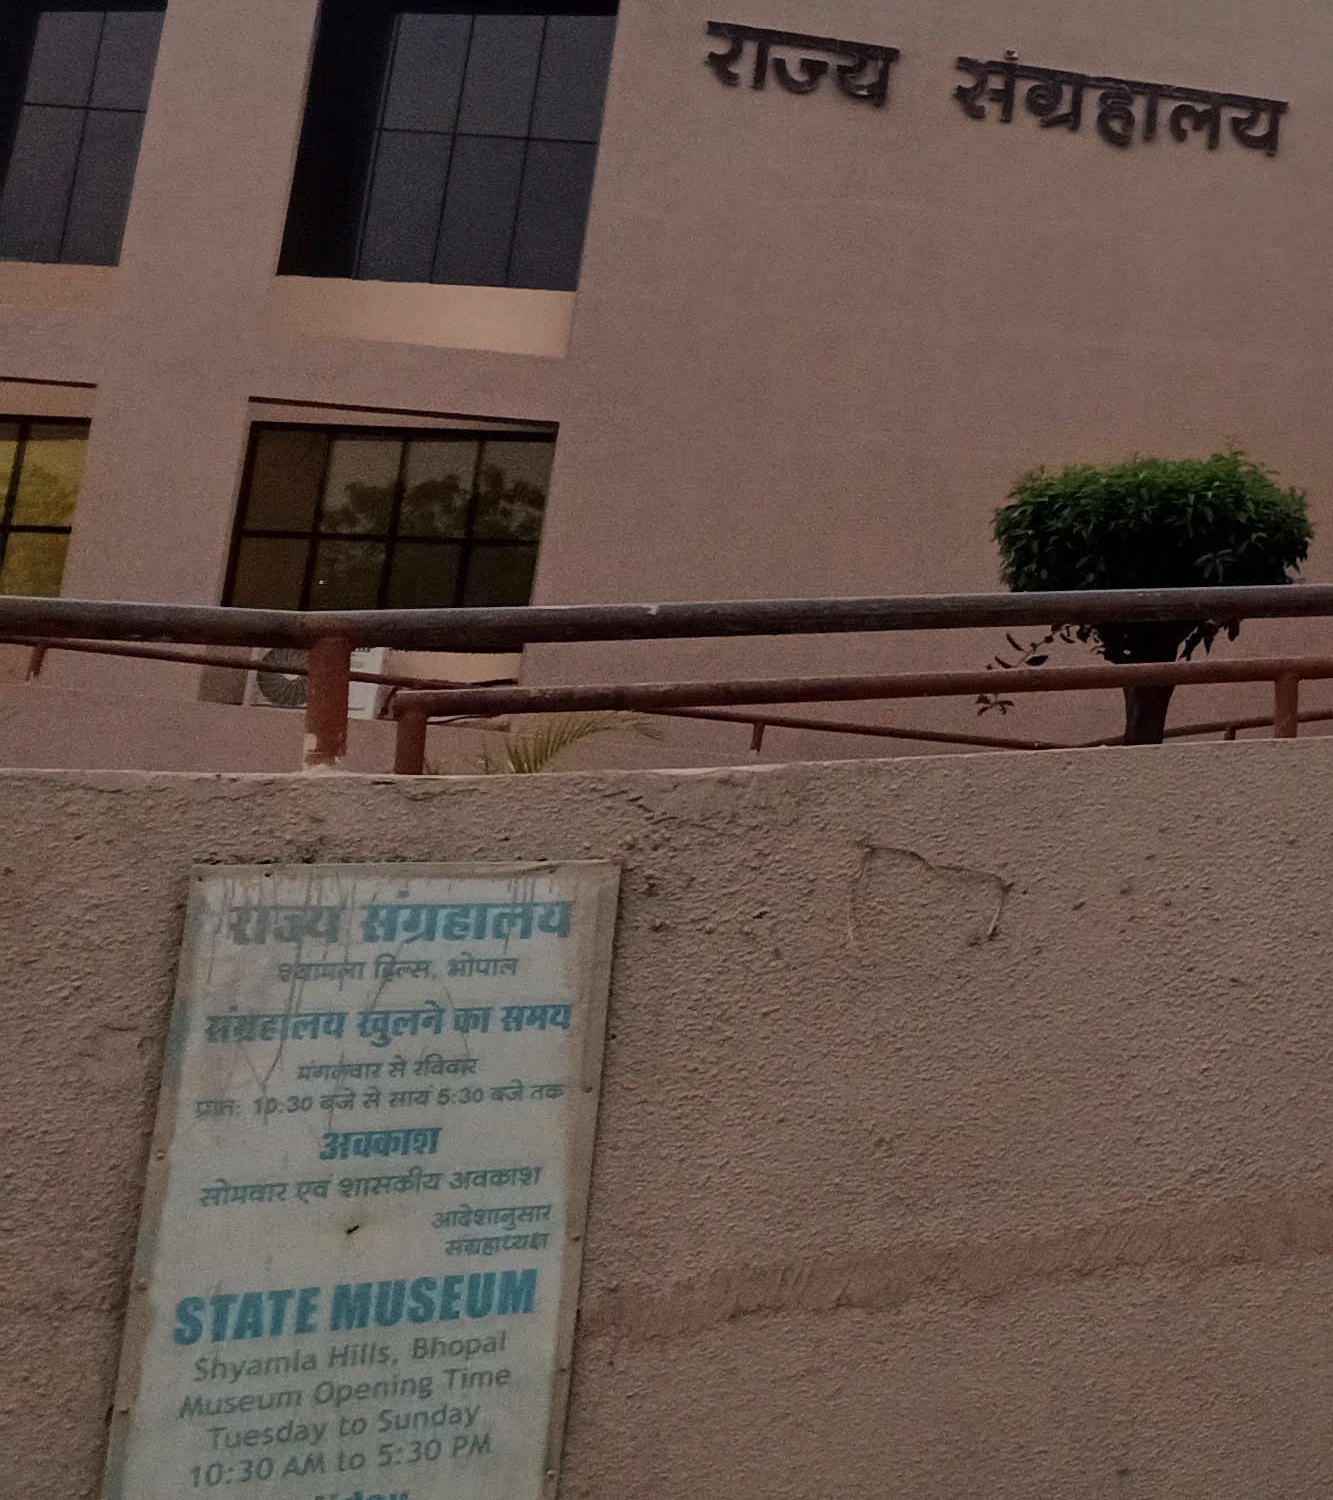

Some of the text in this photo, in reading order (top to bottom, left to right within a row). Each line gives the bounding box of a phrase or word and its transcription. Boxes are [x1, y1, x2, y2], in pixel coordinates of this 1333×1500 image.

[706, 20, 1289, 156] राज्य संग्रहालय
[362, 891, 573, 944] संग्रहालय
[447, 954, 519, 976] भोपाल
[205, 1000, 572, 1047] संग्रहालय खुलने का समय
[389, 1054, 408, 1077] से
[362, 1086, 382, 1109] से
[437, 1086, 484, 1105] 5:30
[530, 1083, 566, 1100] तक
[319, 1127, 441, 1160] अवकाश
[200, 1178, 288, 1208] सोमवार
[339, 1166, 440, 1198] शासकीय
[450, 1165, 541, 1190] अवकाश
[173, 1268, 538, 1345] STATE MUSEUM
[193, 1330, 507, 1383] Shyamla Hills, Bhopal
[179, 1364, 512, 1419] Museum Opening Time
[207, 1401, 480, 1451] Tuesday to Sunday
[190, 1432, 491, 1488] 10:30 AM to 5:30 PM
